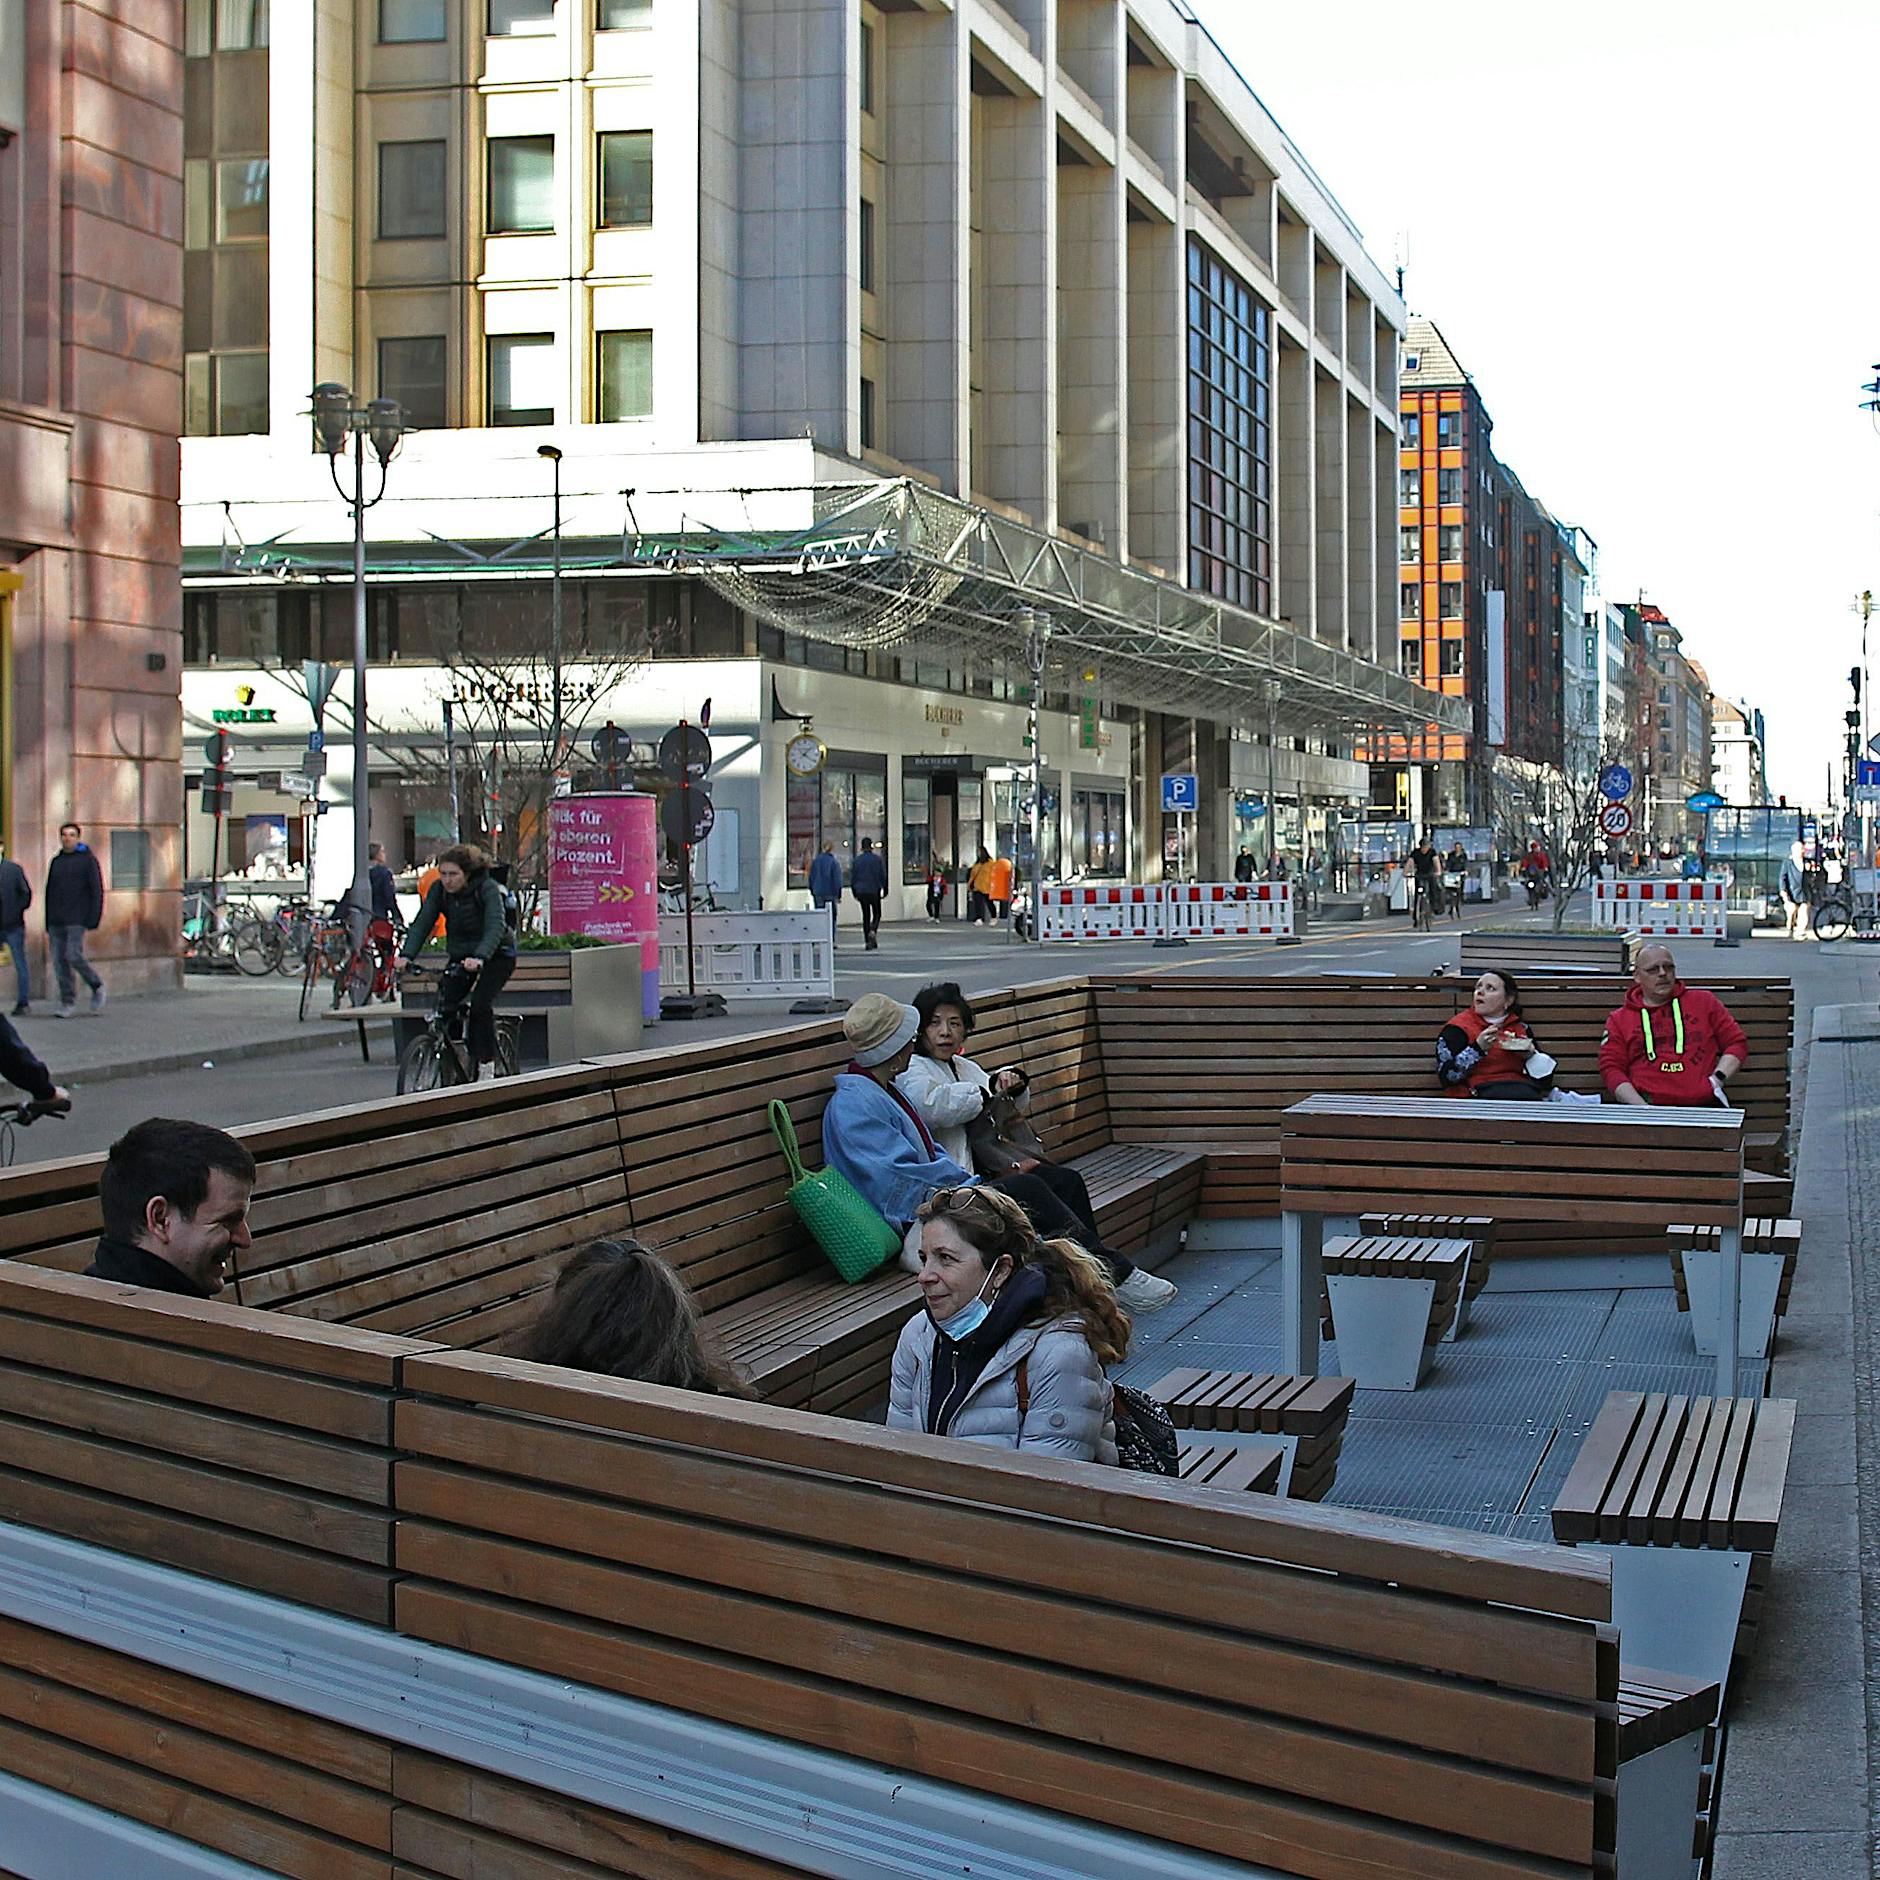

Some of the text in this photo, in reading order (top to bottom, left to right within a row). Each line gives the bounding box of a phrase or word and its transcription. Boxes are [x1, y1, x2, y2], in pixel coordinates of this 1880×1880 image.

[212, 709, 277, 722] ROLEX
[1174, 783, 1186, 800] P
[580, 809, 602, 825] für
[1606, 812, 1625, 827] 20
[559, 829, 611, 845] oberen
[557, 847, 616, 865] Prozent.
